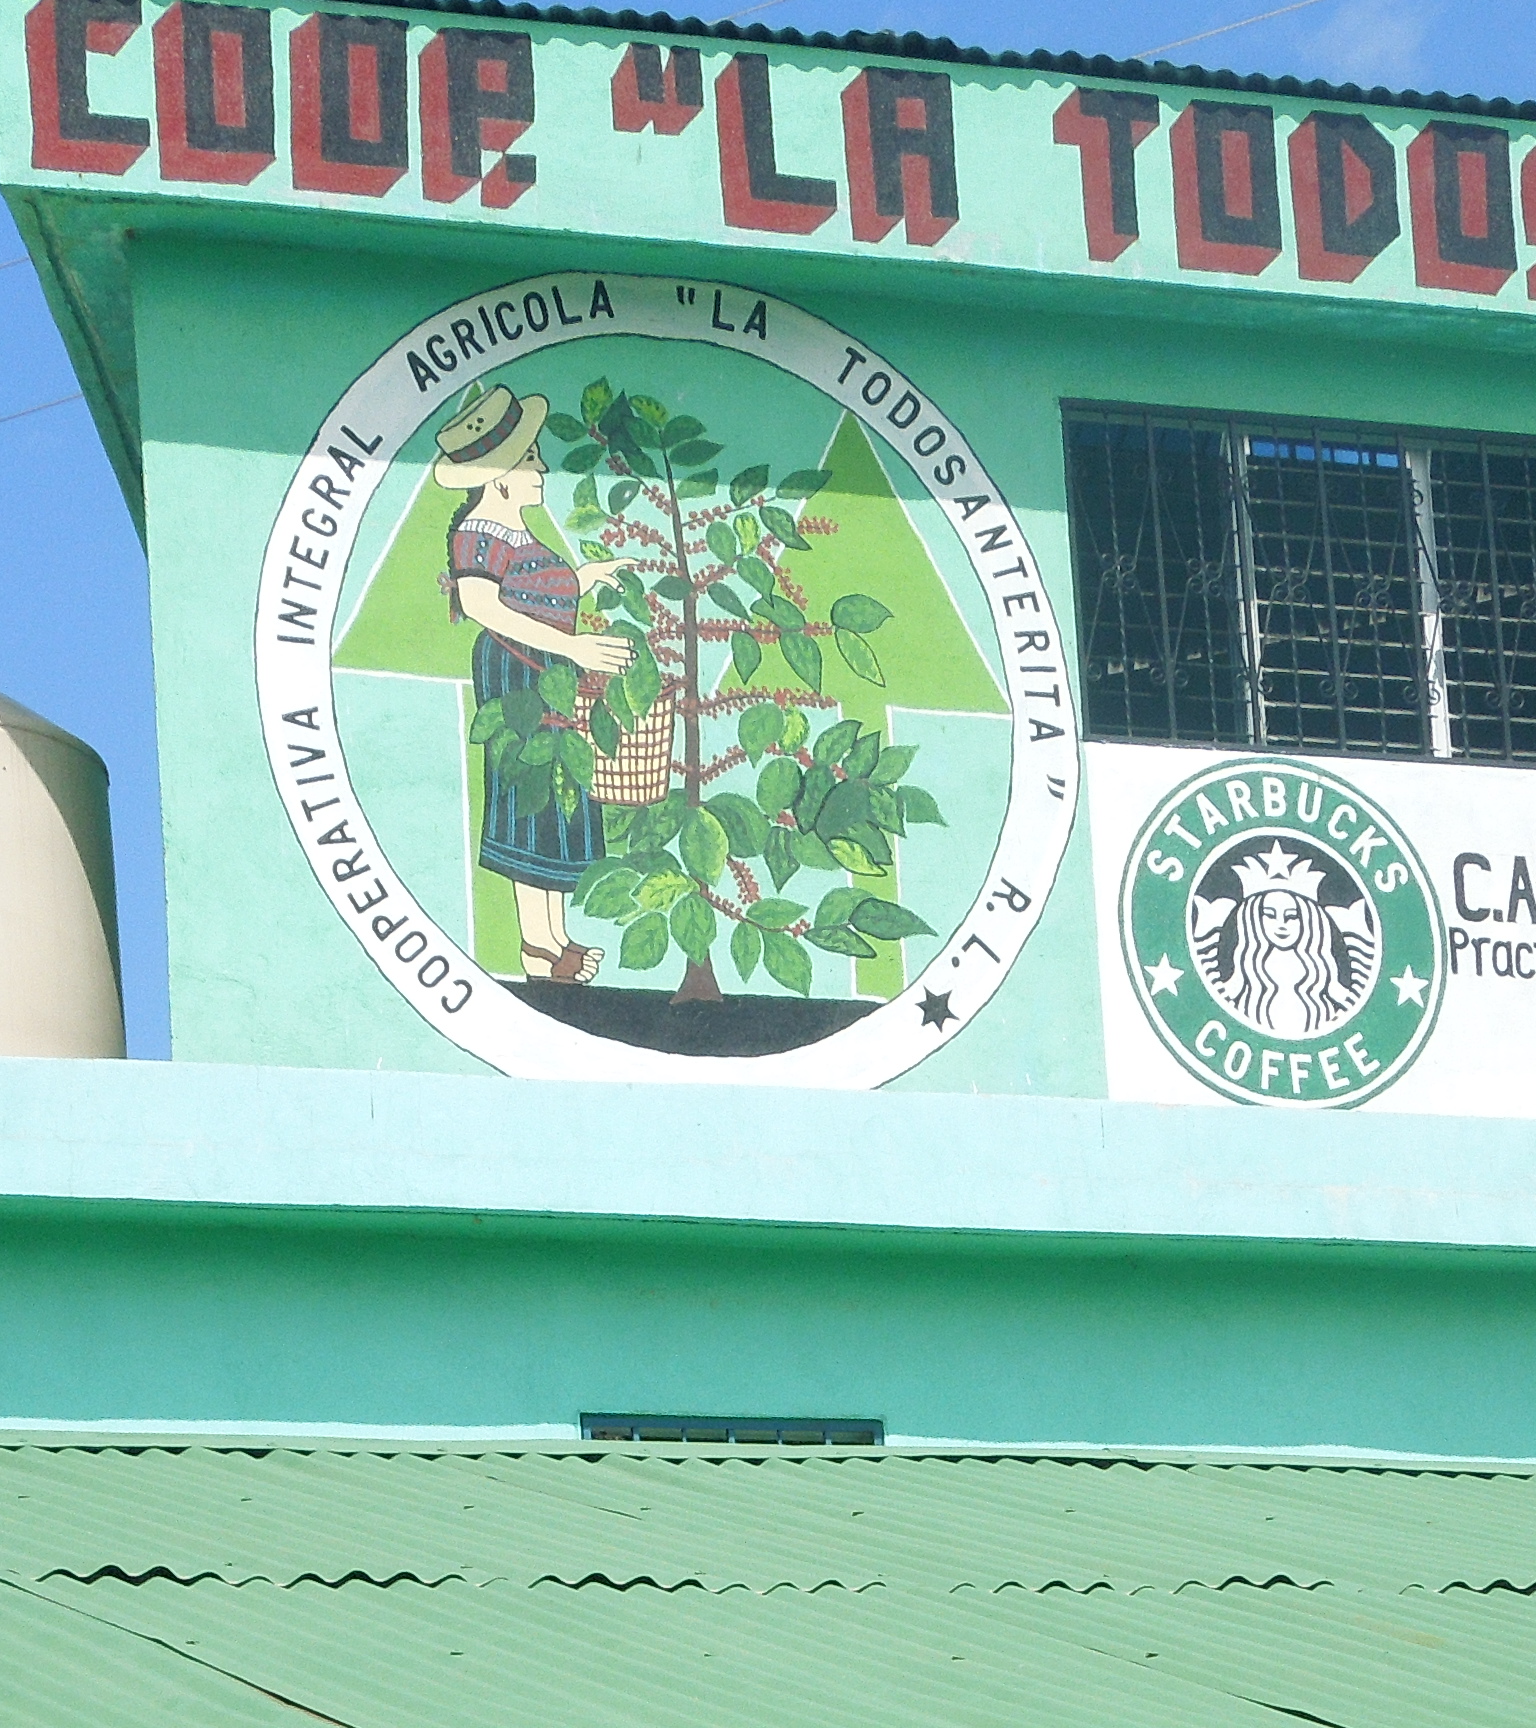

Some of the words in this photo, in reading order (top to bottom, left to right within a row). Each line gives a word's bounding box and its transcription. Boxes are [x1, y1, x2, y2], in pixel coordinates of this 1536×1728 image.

[24, 0, 537, 209] COOP.
[610, 41, 961, 247] "LA
[405, 279, 615, 393] AGRICOLA
[675, 285, 768, 341] "LA
[276, 423, 385, 646] INTEGRAL
[281, 705, 473, 1014] COOPERATIVA
[1146, 776, 1409, 894] STARBUCKS
[1195, 1018, 1382, 1095] COFFEE
